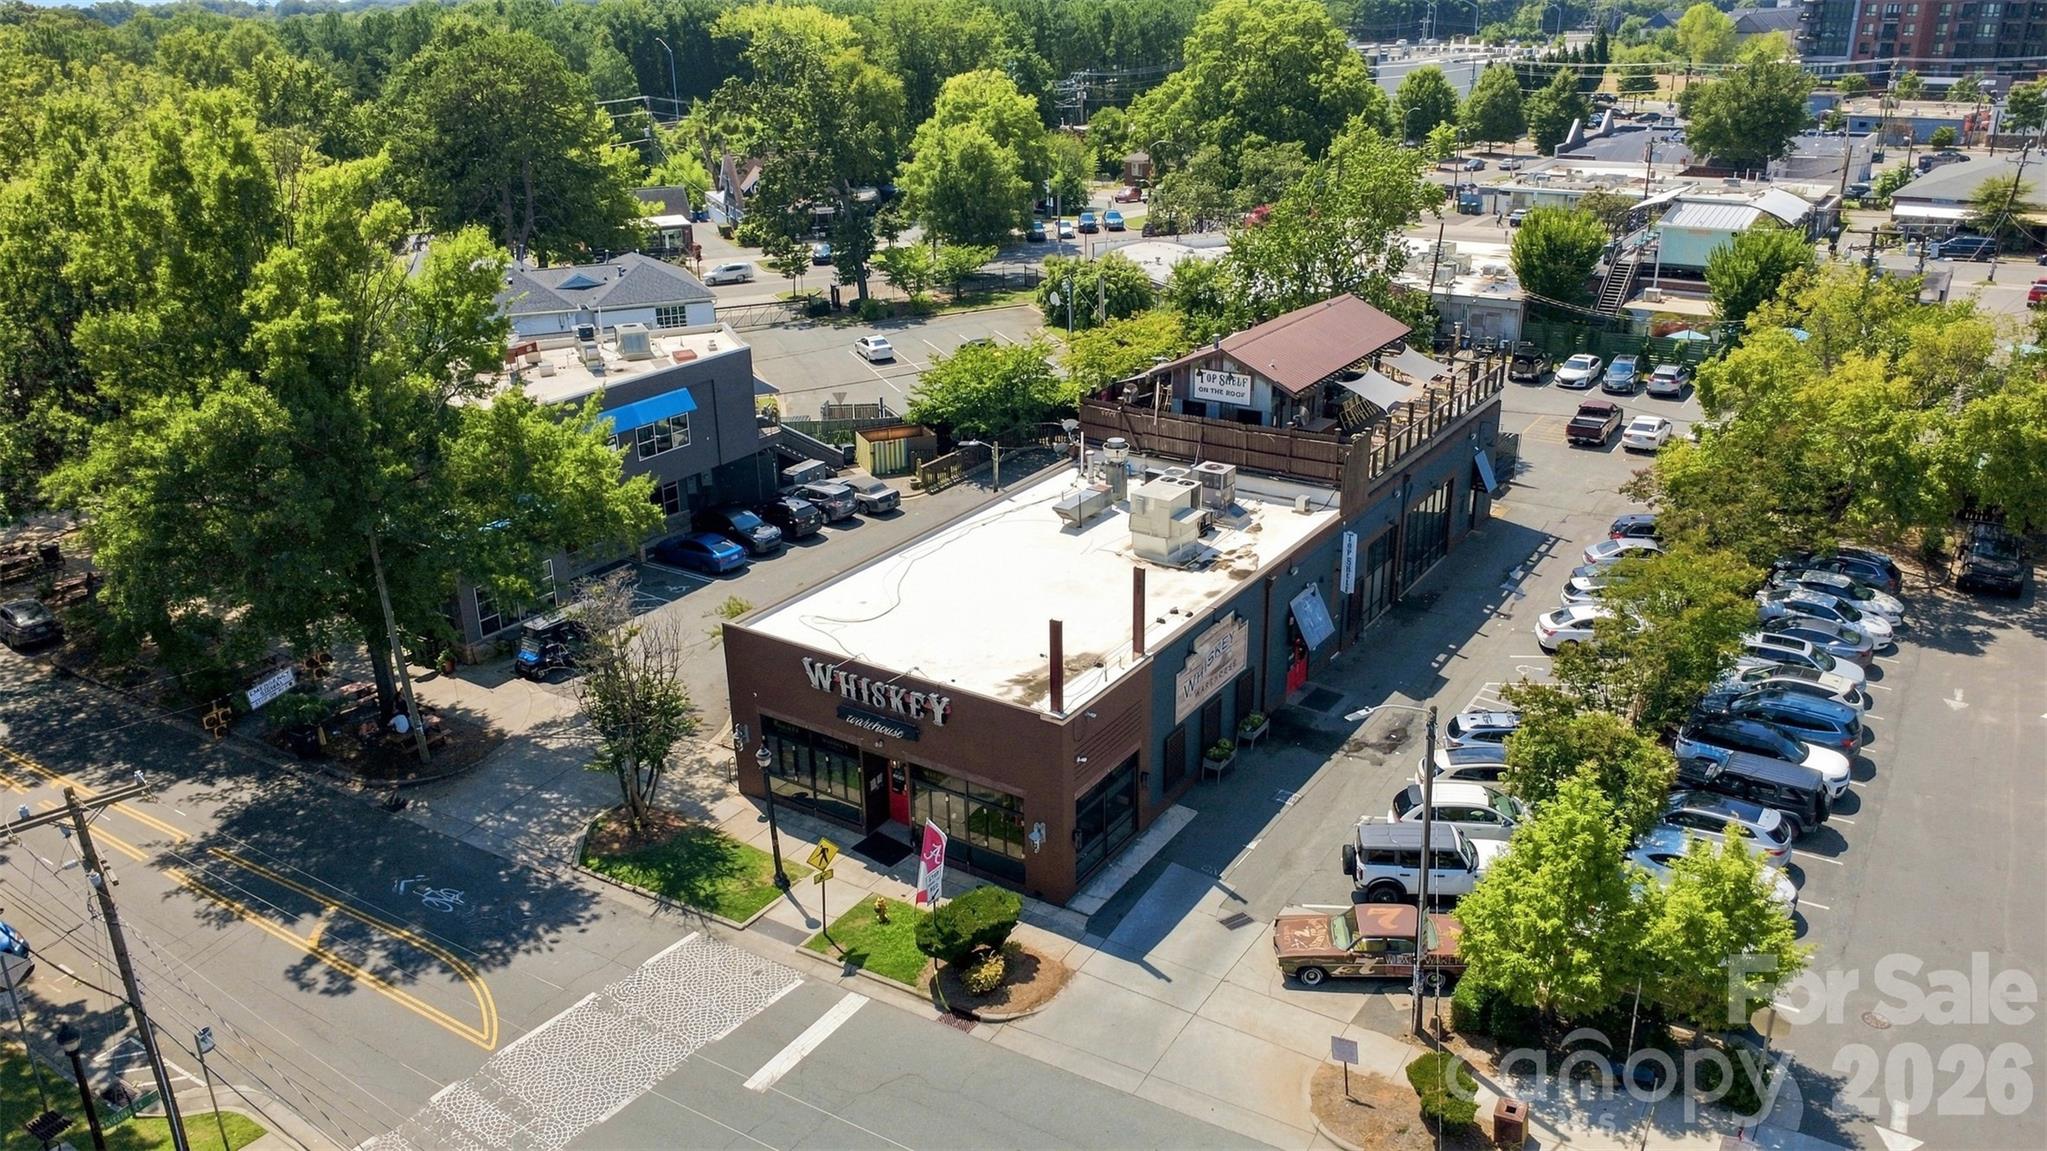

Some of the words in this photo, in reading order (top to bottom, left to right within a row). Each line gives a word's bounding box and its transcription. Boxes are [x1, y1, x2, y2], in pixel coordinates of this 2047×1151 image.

[1199, 371, 1217, 384] TOP
[1219, 374, 1248, 387] SHELF
[1210, 388, 1224, 396] THE
[1183, 630, 1236, 699] WHISKEY
[801, 656, 951, 727] WHISKEY
[845, 713, 904, 739] warehouse
